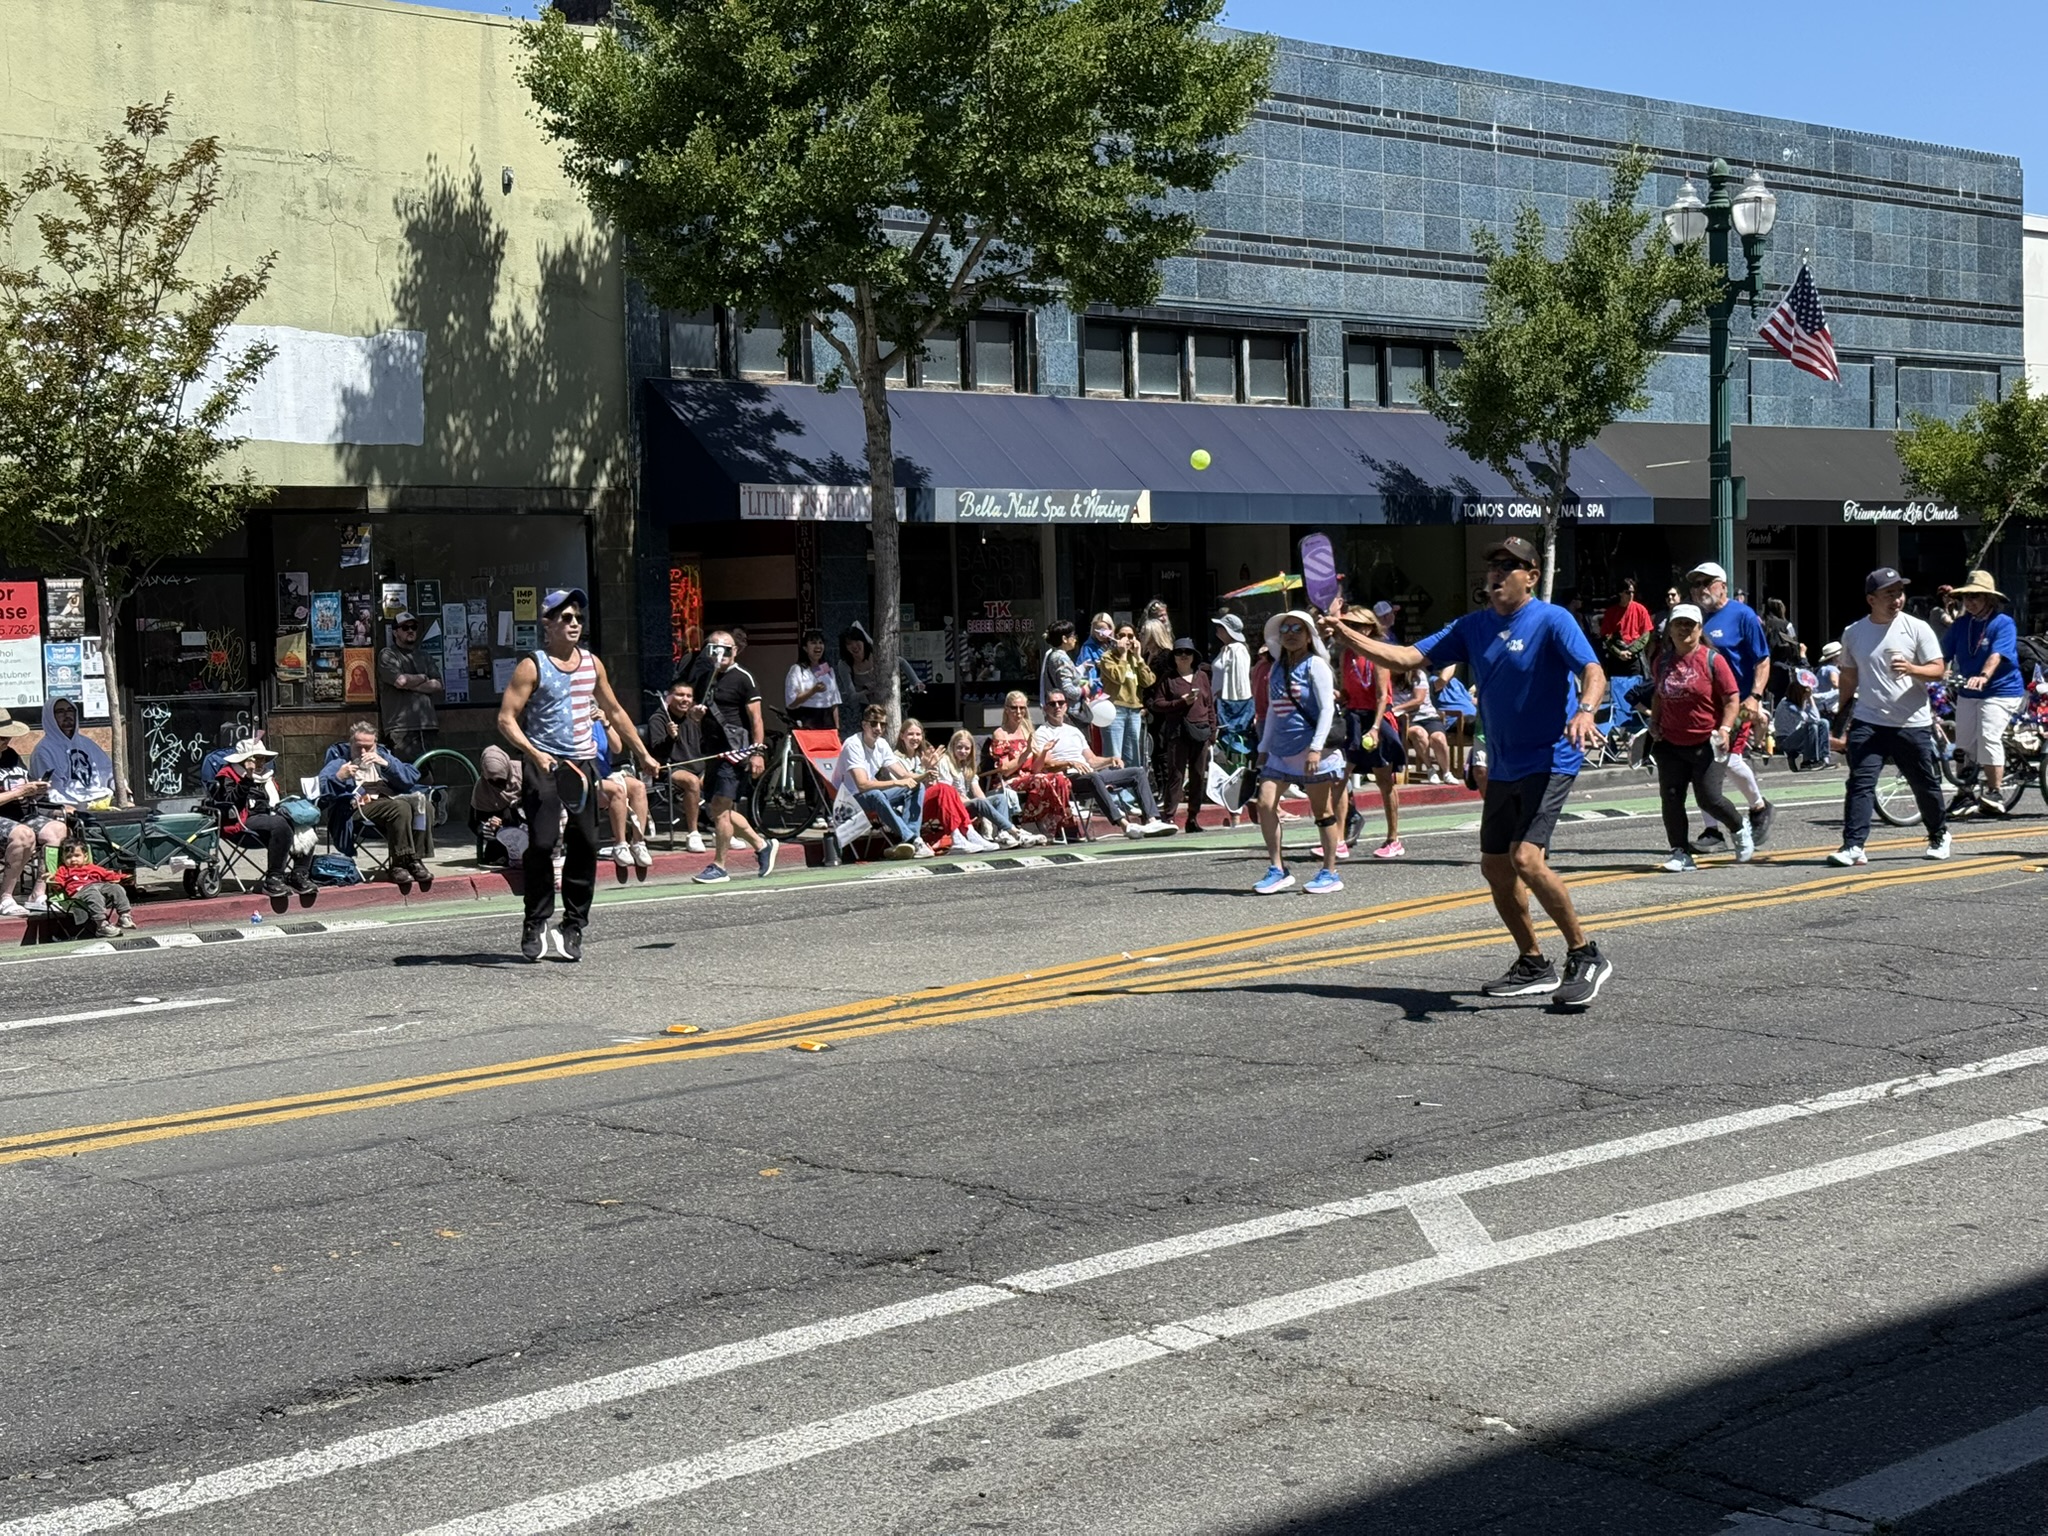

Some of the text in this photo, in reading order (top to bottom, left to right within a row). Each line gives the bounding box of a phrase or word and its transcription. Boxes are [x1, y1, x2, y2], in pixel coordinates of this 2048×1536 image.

[959, 491, 1130, 522] Bella Nail Spa & Waxing
[1463, 503, 1504, 518] TOMO'S
[1561, 504, 1584, 517] NAIL
[1586, 503, 1605, 518] SPA
[1844, 500, 1959, 525] Triumphant Life Church
[517, 590, 533, 598] IMP
[983, 600, 1012, 618] TK
[967, 619, 995, 633] BARBER
[995, 619, 1014, 633] SHOP
